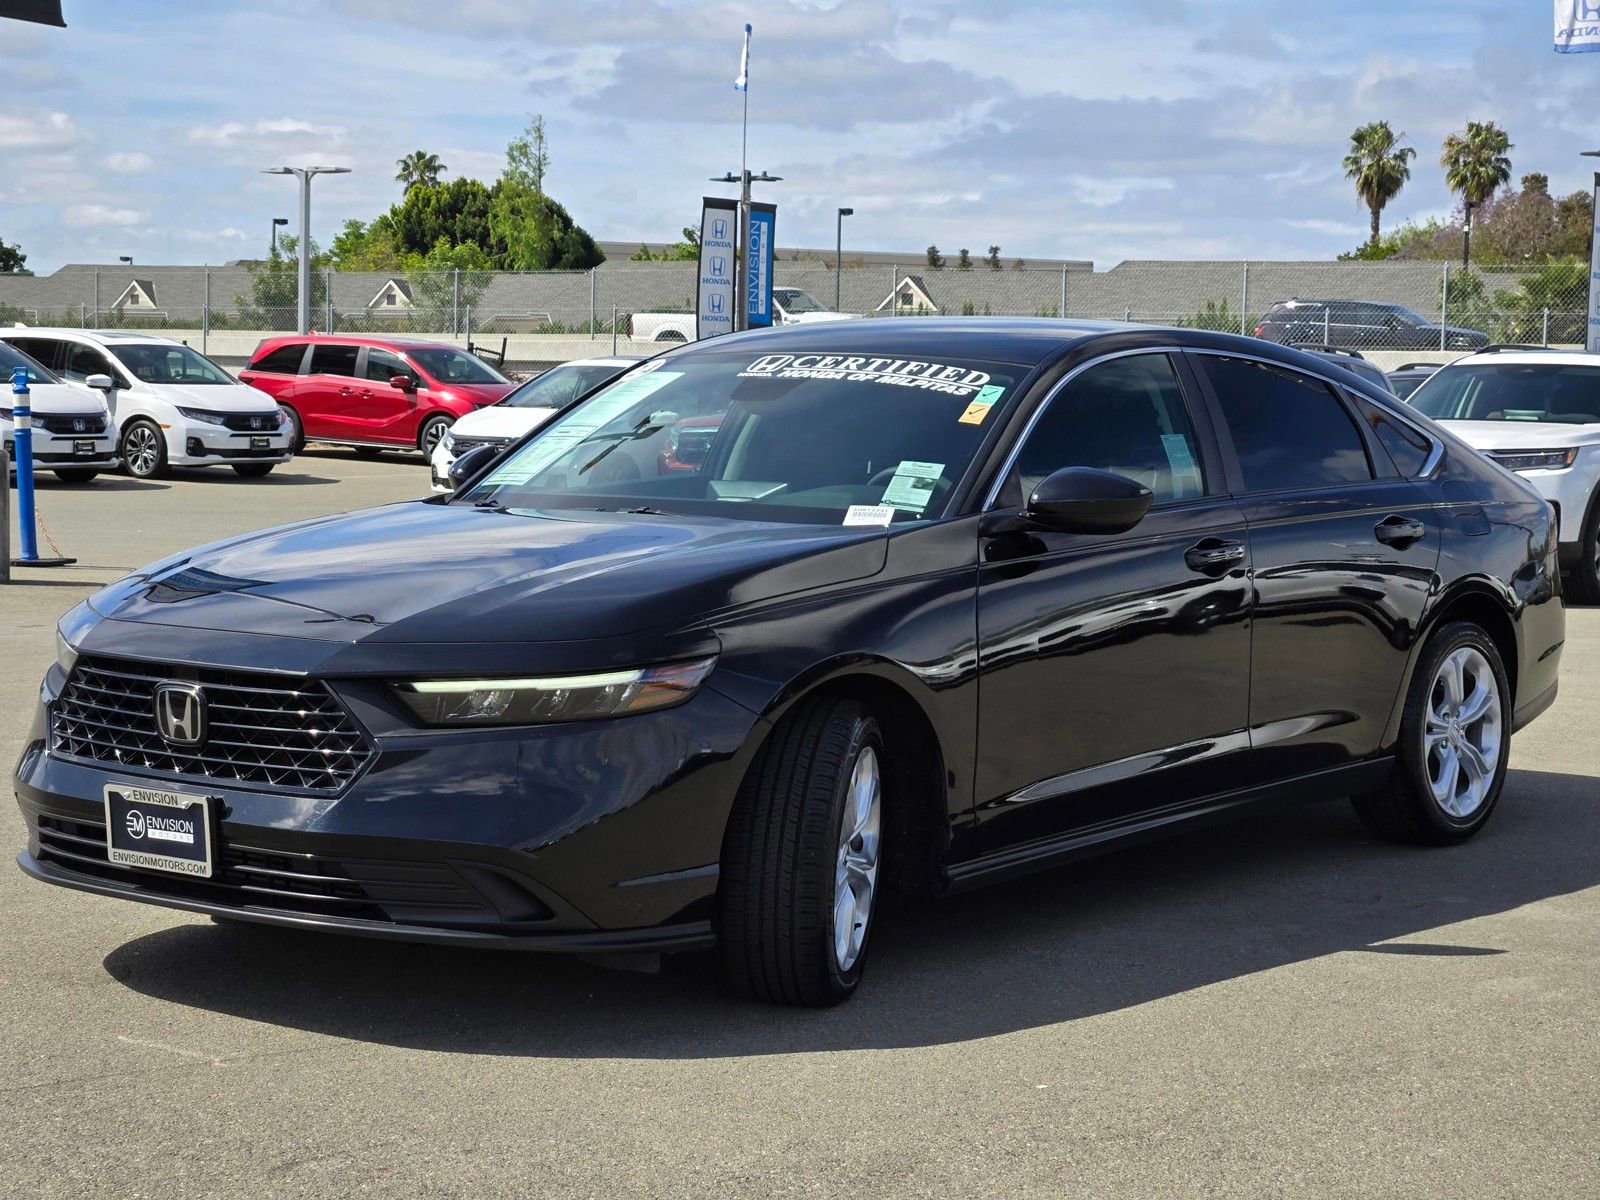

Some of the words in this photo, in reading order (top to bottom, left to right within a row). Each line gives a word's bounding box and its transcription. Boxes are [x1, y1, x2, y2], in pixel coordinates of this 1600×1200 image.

[704, 240, 732, 248] HONDA
[748, 220, 760, 314] ENVISION
[702, 277, 731, 285] HONDA
[792, 355, 991, 386] CERTIFIED
[777, 369, 848, 380] HONDA
[847, 373, 876, 382] OF
[875, 374, 974, 396] MILPITAS
[132, 790, 178, 806] ENVISION
[146, 816, 194, 833] ENVISION
[113, 852, 207, 875] ENVISIONMOTORS.COM
